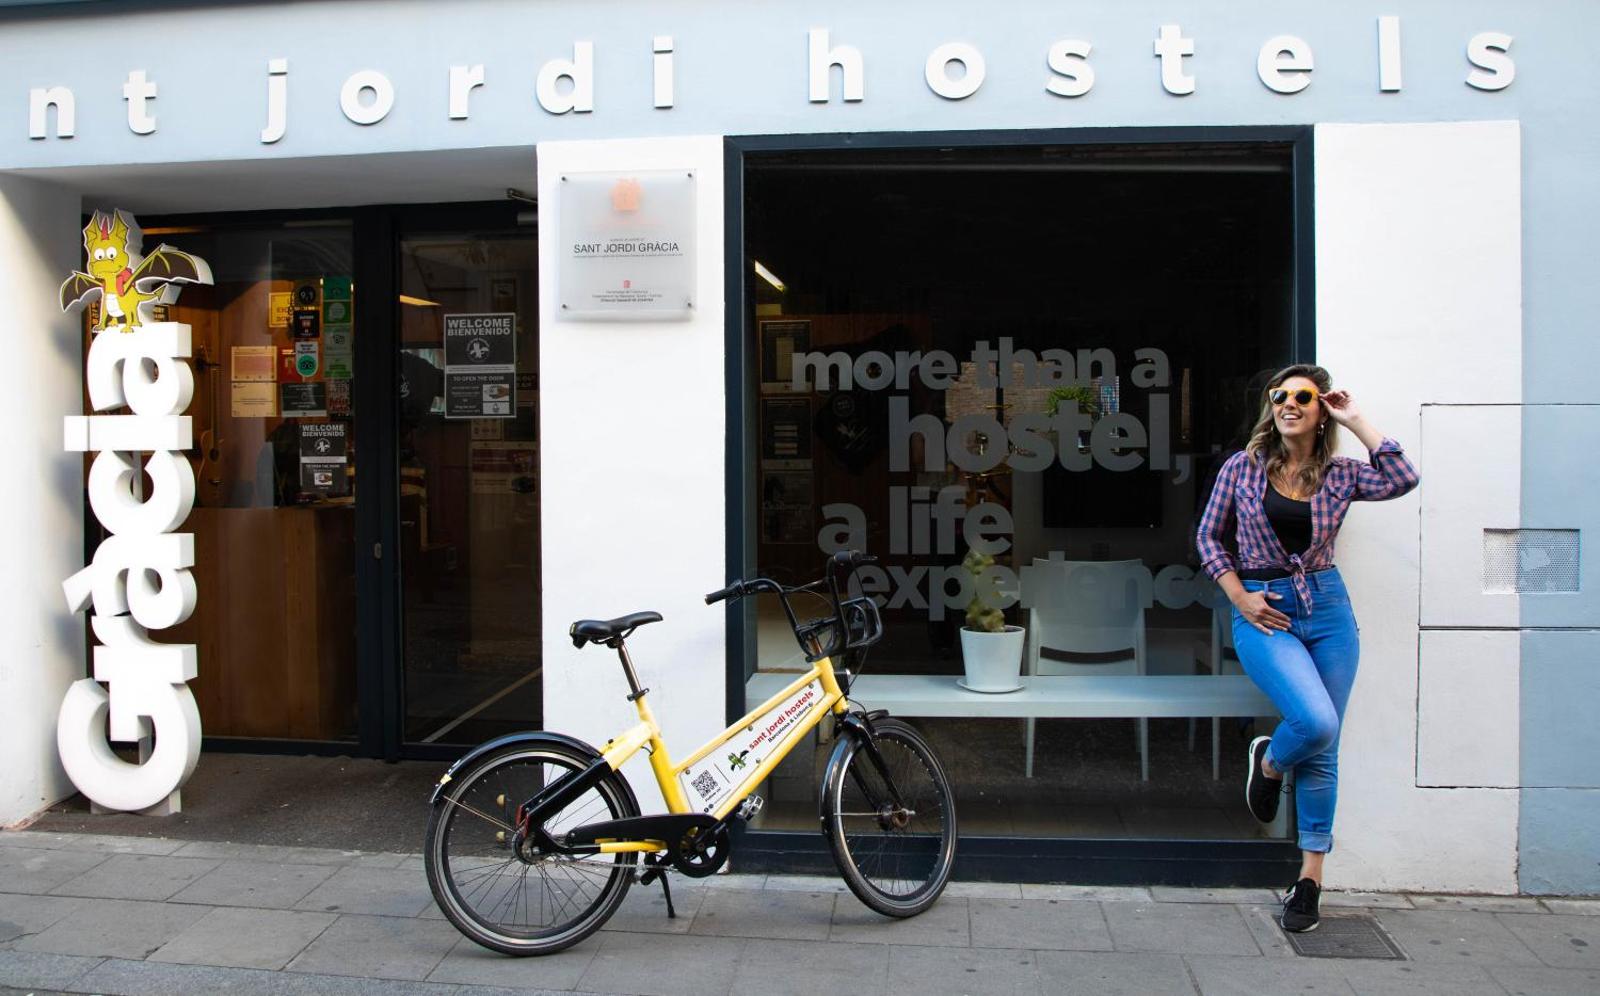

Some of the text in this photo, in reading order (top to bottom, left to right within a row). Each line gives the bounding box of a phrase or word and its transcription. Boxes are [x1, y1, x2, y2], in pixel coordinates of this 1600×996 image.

[261, 35, 674, 143] jordi
[807, 15, 1517, 102] hostels
[573, 241, 680, 254] SANT JORDI GRÀCIA
[447, 318, 511, 328] WELCOME
[447, 327, 511, 336] BIENVENIDO
[792, 336, 1170, 391] more than a
[889, 393, 1191, 485] hostel,
[818, 486, 1014, 555] a life
[57, 321, 202, 811] Gràcia
[750, 691, 814, 749] sant jordi hostels
